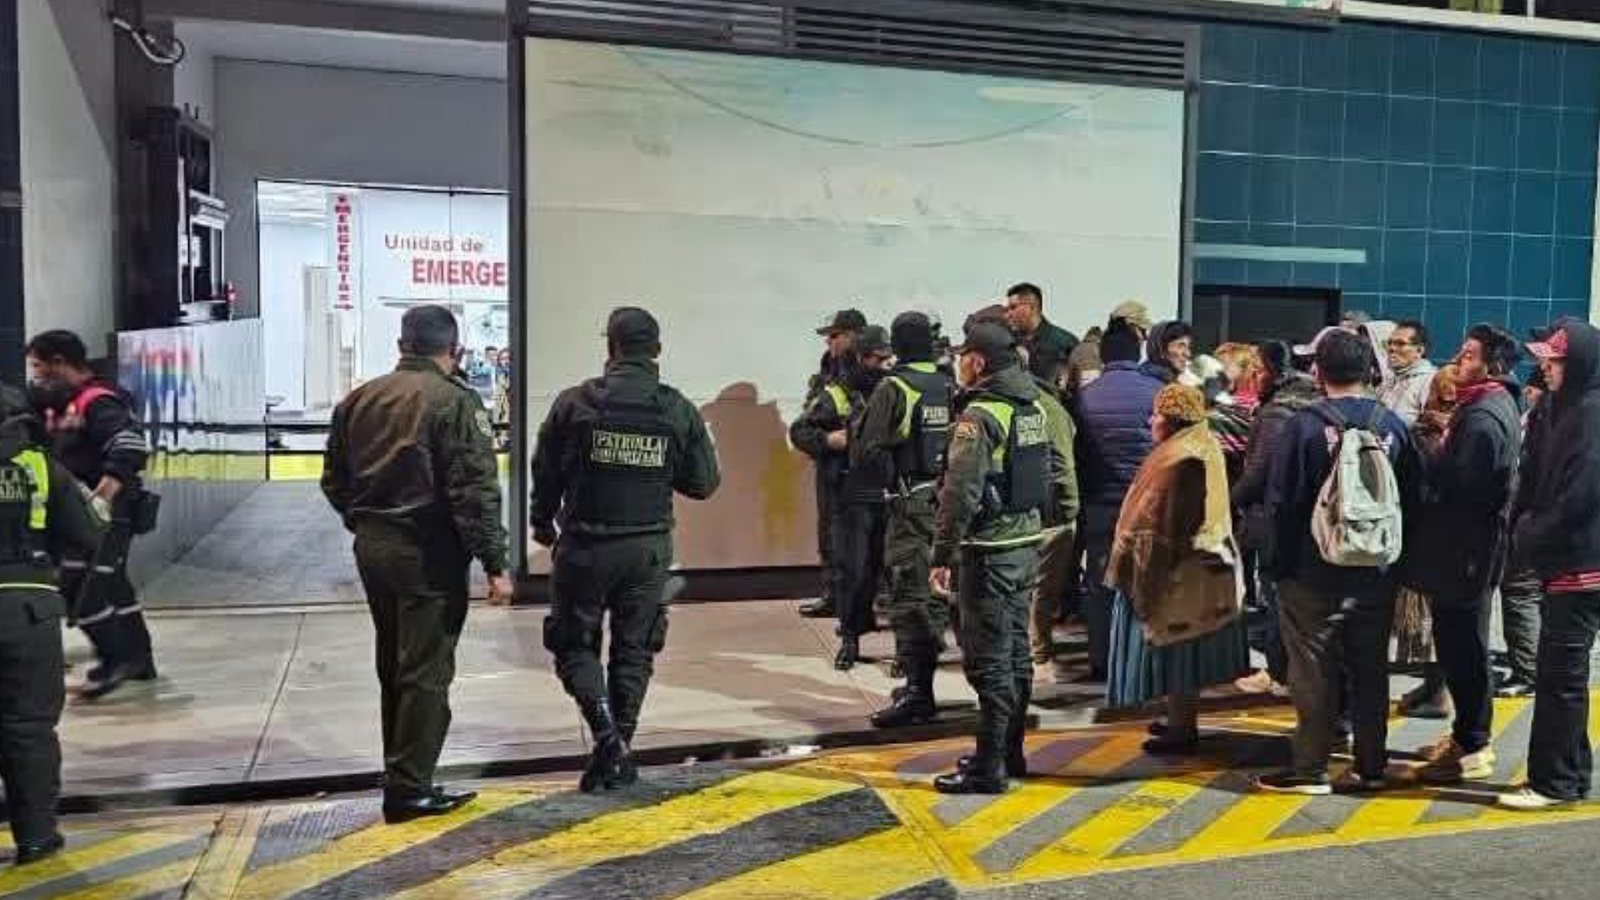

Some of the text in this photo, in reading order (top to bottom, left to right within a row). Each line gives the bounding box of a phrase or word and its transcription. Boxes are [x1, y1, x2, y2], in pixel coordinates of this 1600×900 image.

[384, 233, 484, 252] Unidad de
[412, 258, 506, 287] EMERGE
